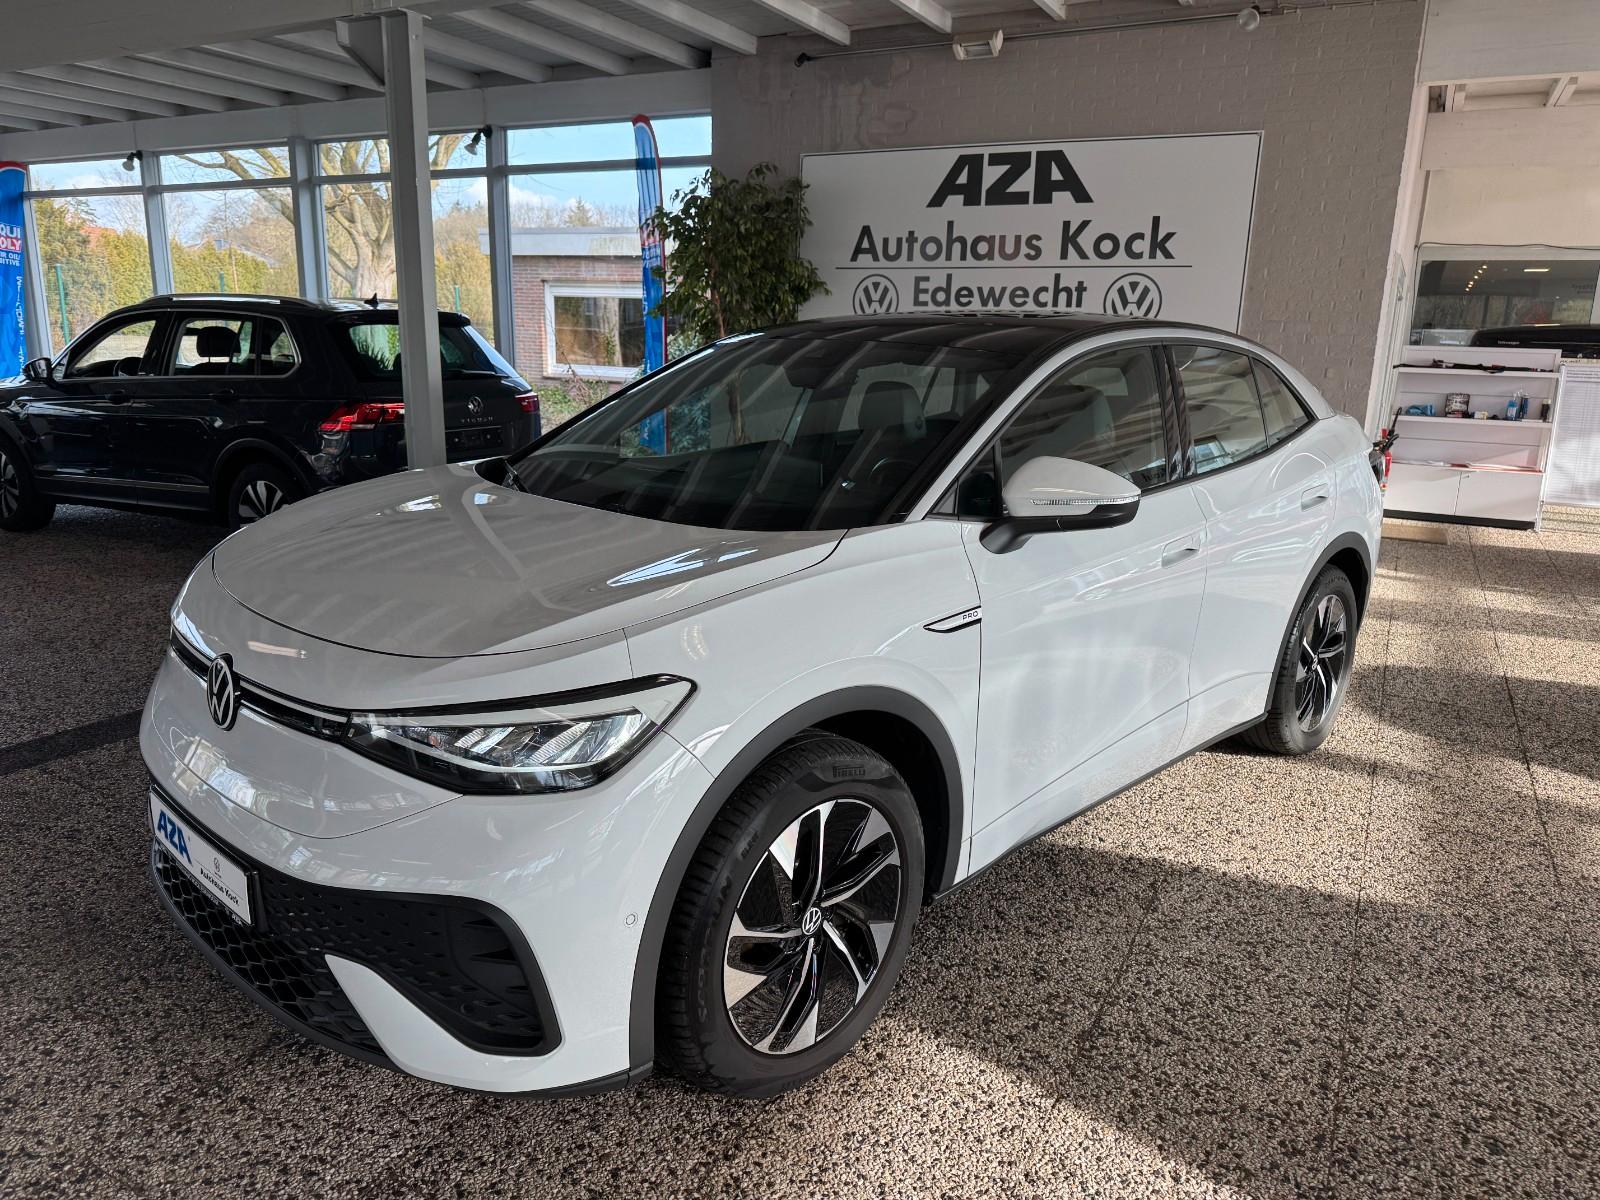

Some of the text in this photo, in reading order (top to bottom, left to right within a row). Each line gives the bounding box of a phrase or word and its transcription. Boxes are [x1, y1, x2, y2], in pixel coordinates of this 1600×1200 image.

[926, 149, 1094, 209] AZA
[850, 216, 1177, 263] Autohaus Kock
[912, 273, 1088, 309] Edewecht
[962, 611, 979, 621] PRO
[157, 809, 193, 866] AZA
